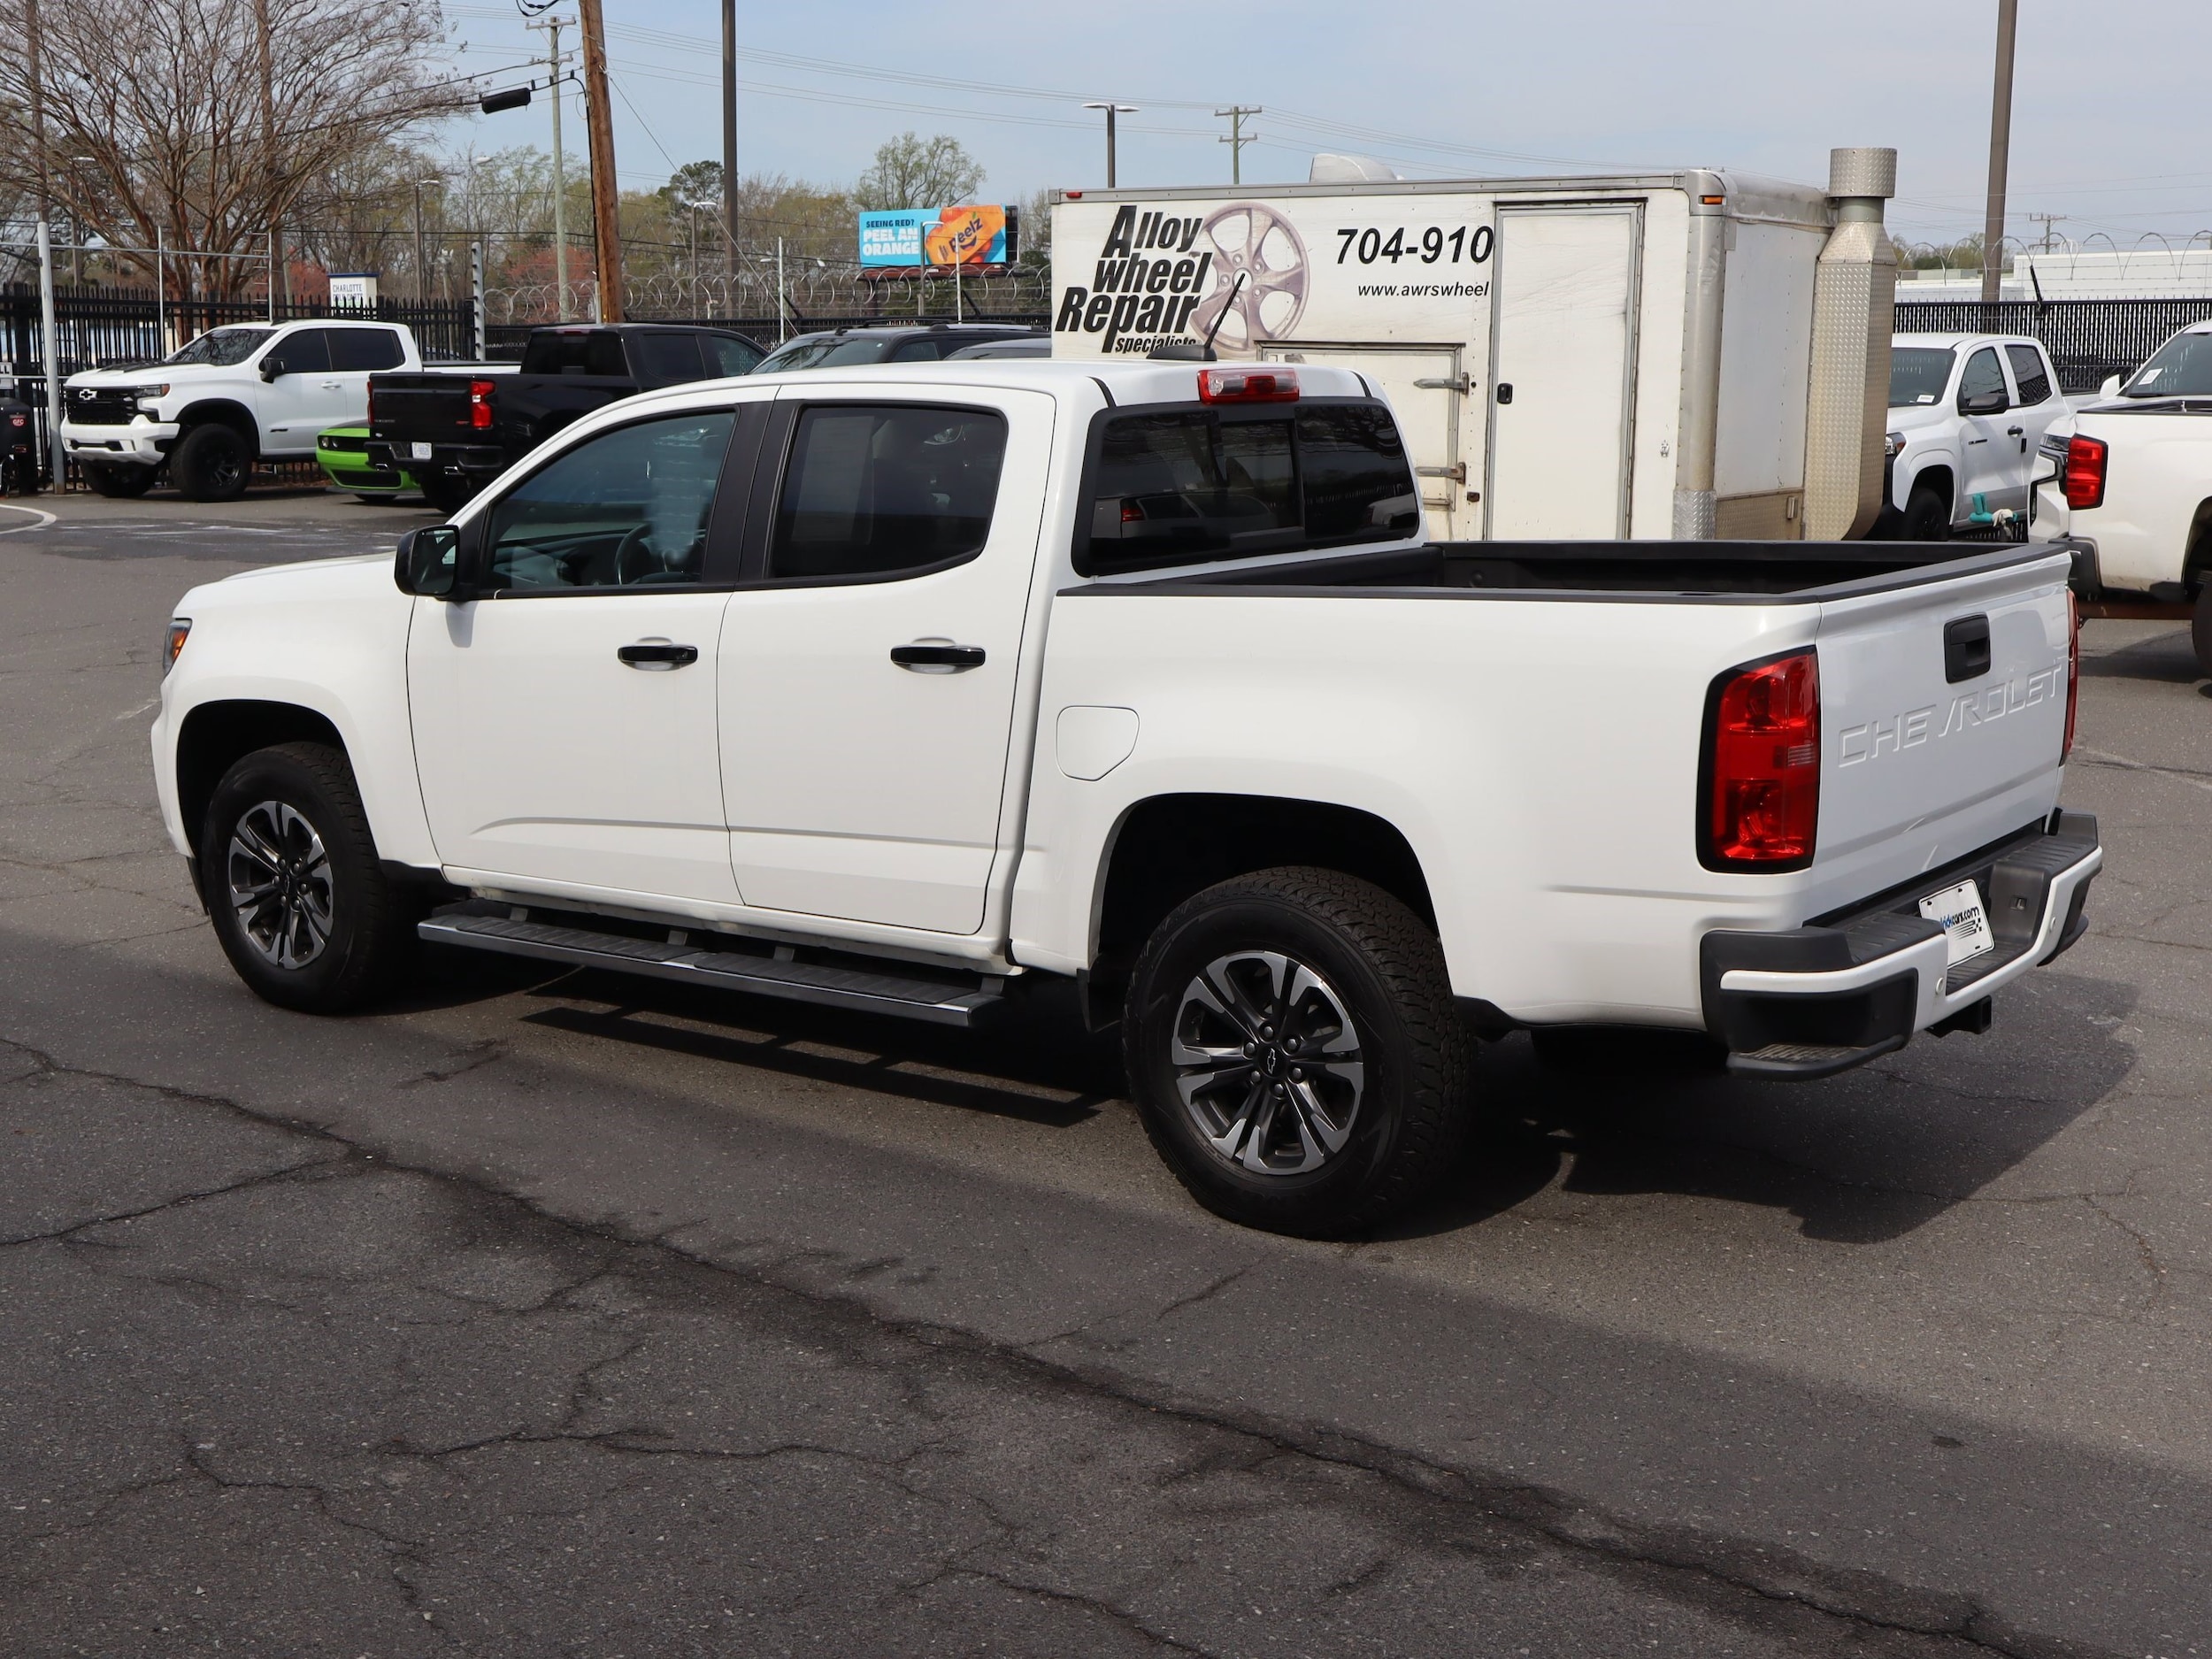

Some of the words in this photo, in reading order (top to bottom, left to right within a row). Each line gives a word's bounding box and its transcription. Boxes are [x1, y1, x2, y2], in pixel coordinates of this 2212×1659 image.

[863, 229, 897, 242] PEEL
[898, 227, 918, 242] AN
[863, 242, 920, 257] ORANGE
[1102, 205, 1202, 257] Alloy
[1337, 226, 1494, 265] 704-910
[333, 284, 363, 293] CHARLOTTE
[1093, 252, 1212, 293] wheel
[1358, 281, 1489, 296] www.awrswheel
[1055, 287, 1201, 353] Repair
[1838, 663, 2062, 768] CHEVROLET
